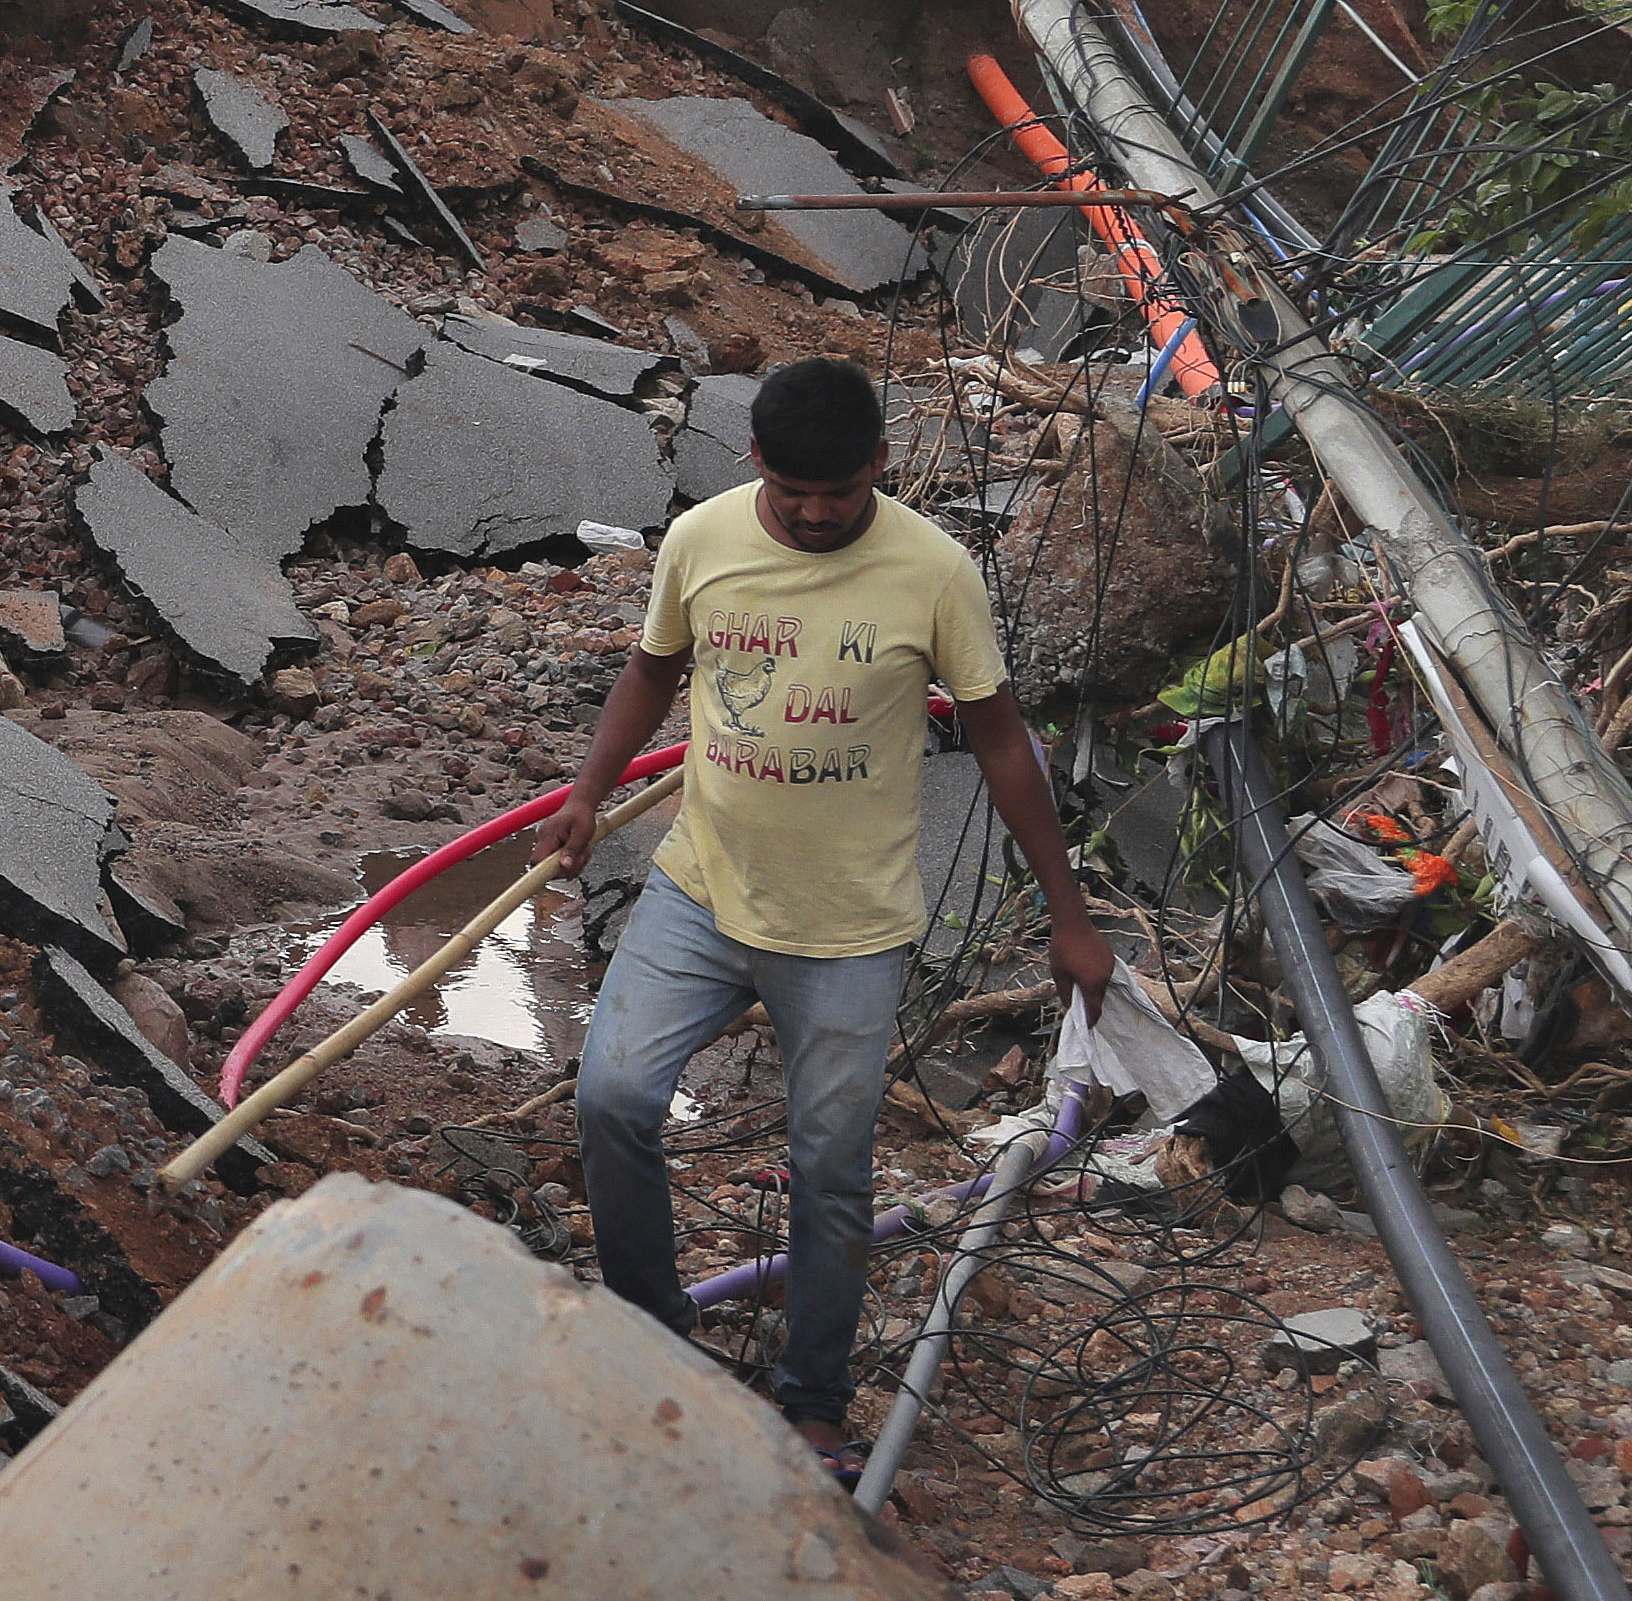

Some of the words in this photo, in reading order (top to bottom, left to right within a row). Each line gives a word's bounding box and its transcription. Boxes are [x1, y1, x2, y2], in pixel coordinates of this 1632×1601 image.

[708, 609, 804, 659] GHAR
[838, 619, 878, 665] KI
[784, 683, 860, 725] DAL
[705, 727, 871, 784] BARABAR
